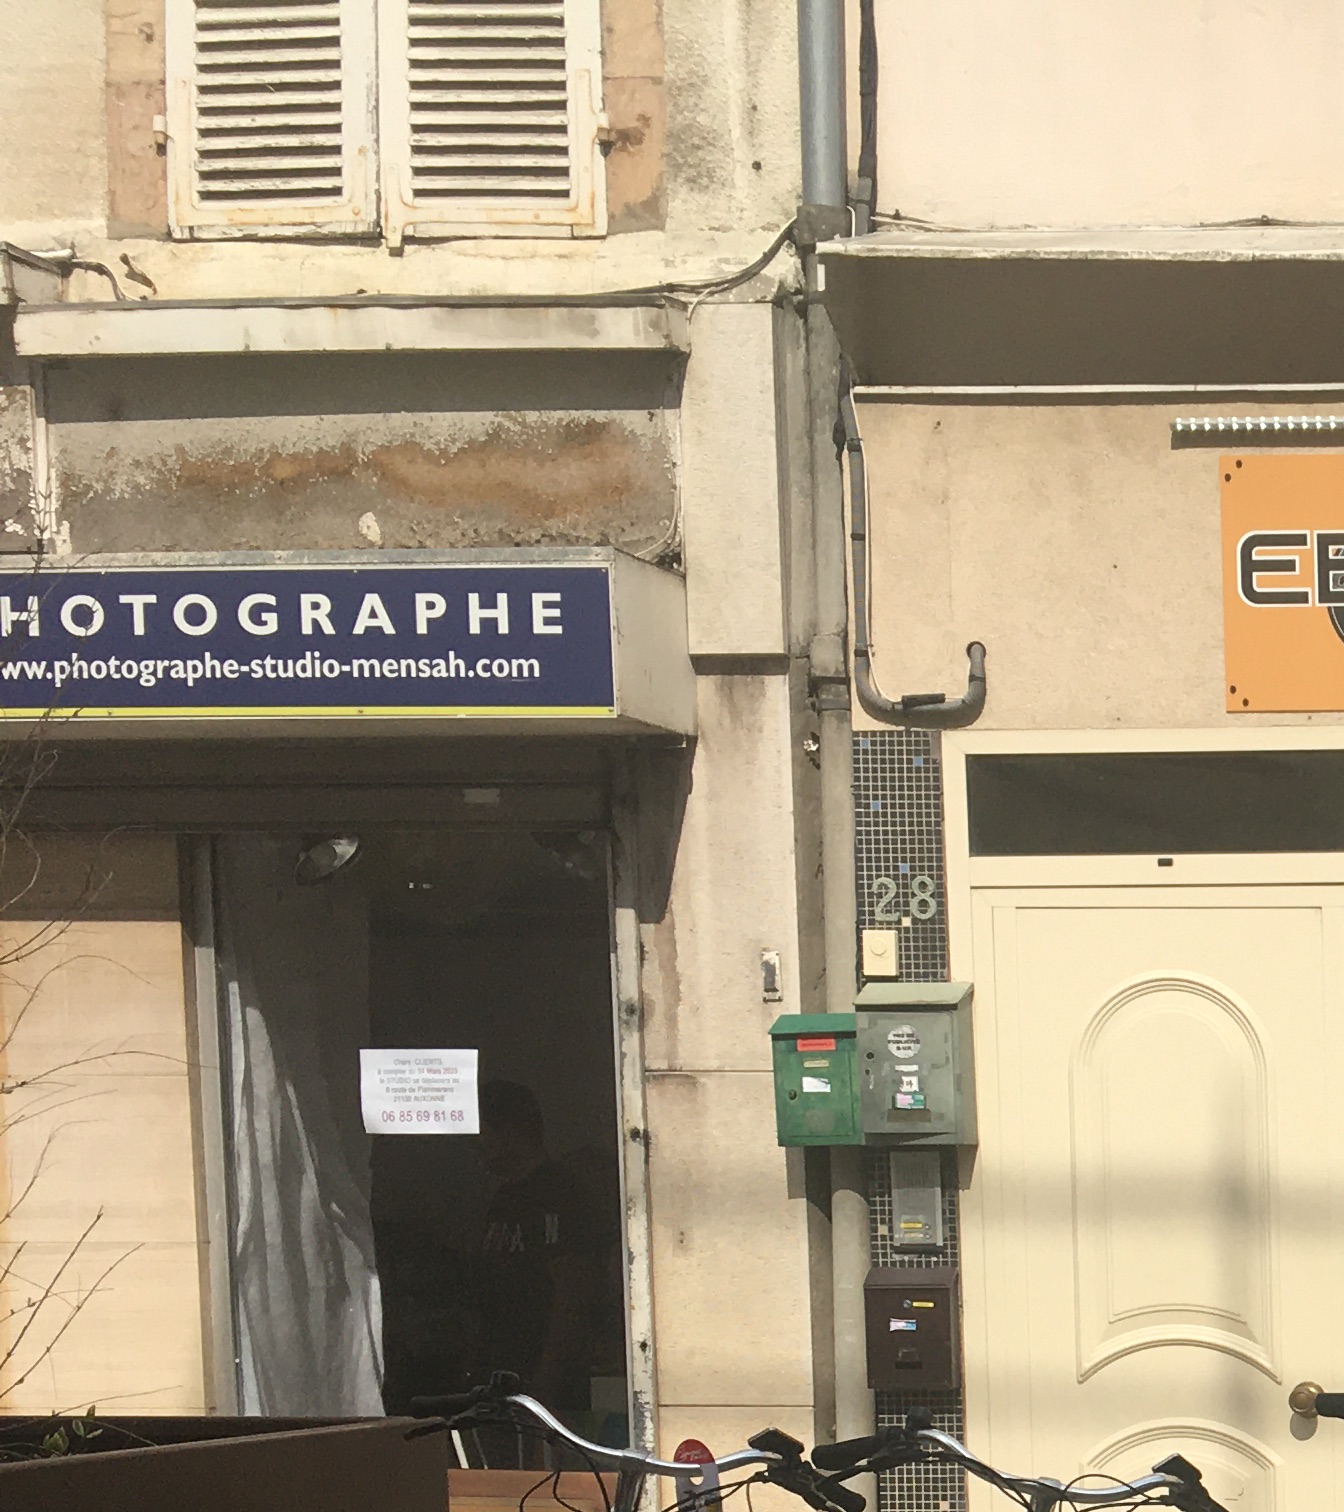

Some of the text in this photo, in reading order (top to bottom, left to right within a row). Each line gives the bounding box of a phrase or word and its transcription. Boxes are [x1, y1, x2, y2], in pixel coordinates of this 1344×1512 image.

[872, 876, 937, 921] 28
[381, 1109, 465, 1123] 06 85 69 81 68
